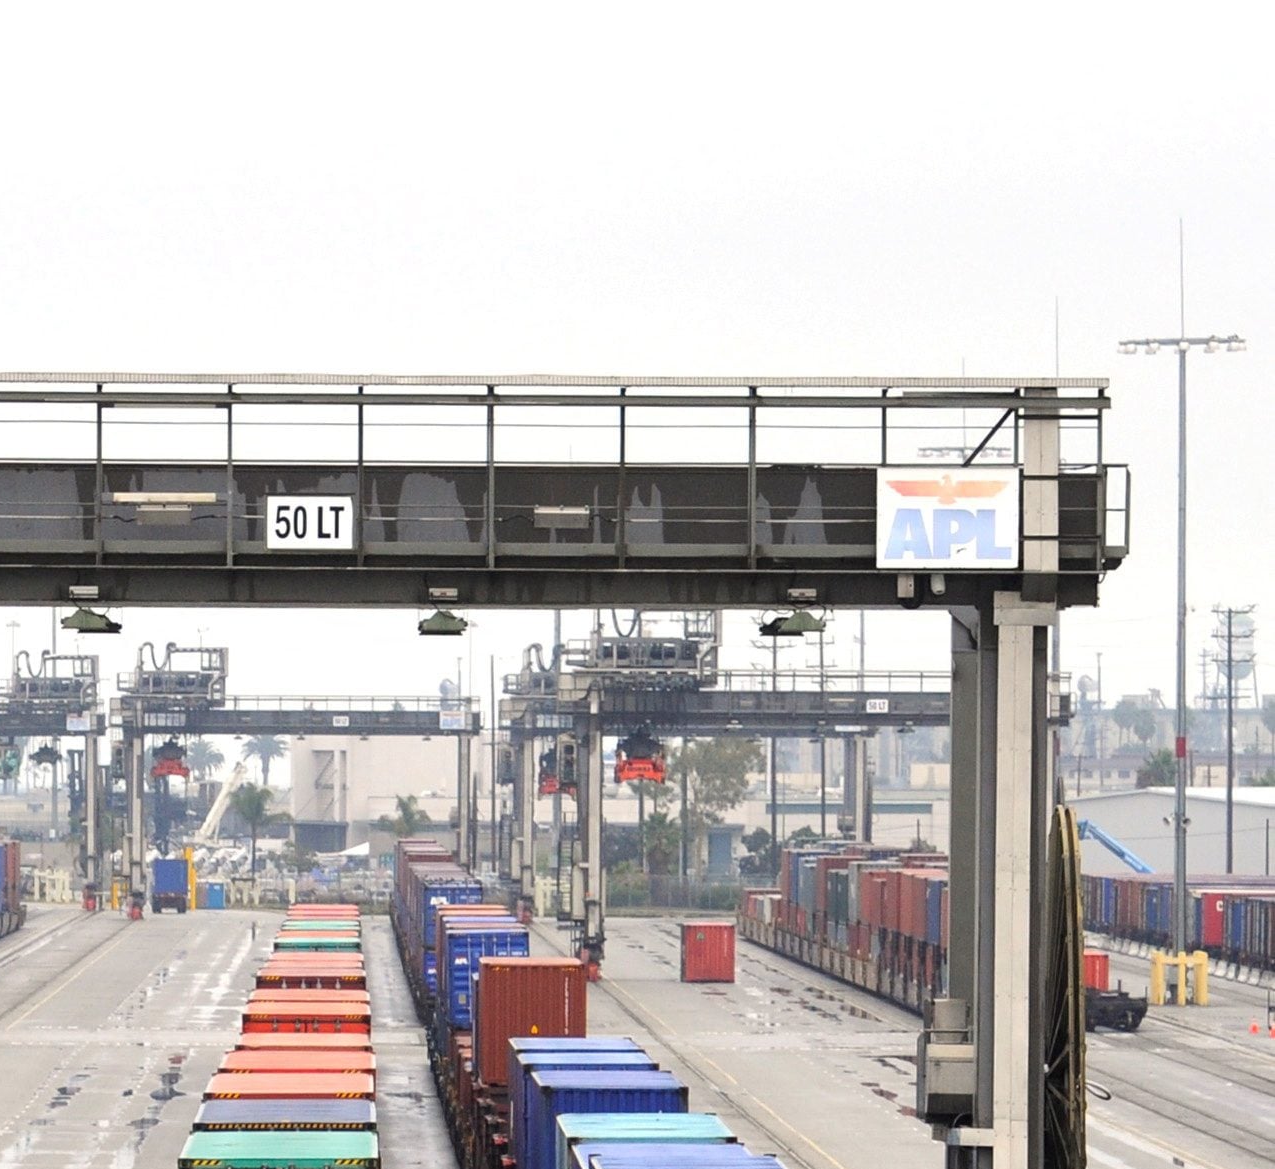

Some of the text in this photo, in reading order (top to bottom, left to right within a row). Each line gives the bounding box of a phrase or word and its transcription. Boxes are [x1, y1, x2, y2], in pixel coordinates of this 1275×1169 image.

[275, 505, 345, 539] 50 LT
[883, 507, 1013, 560] APL
